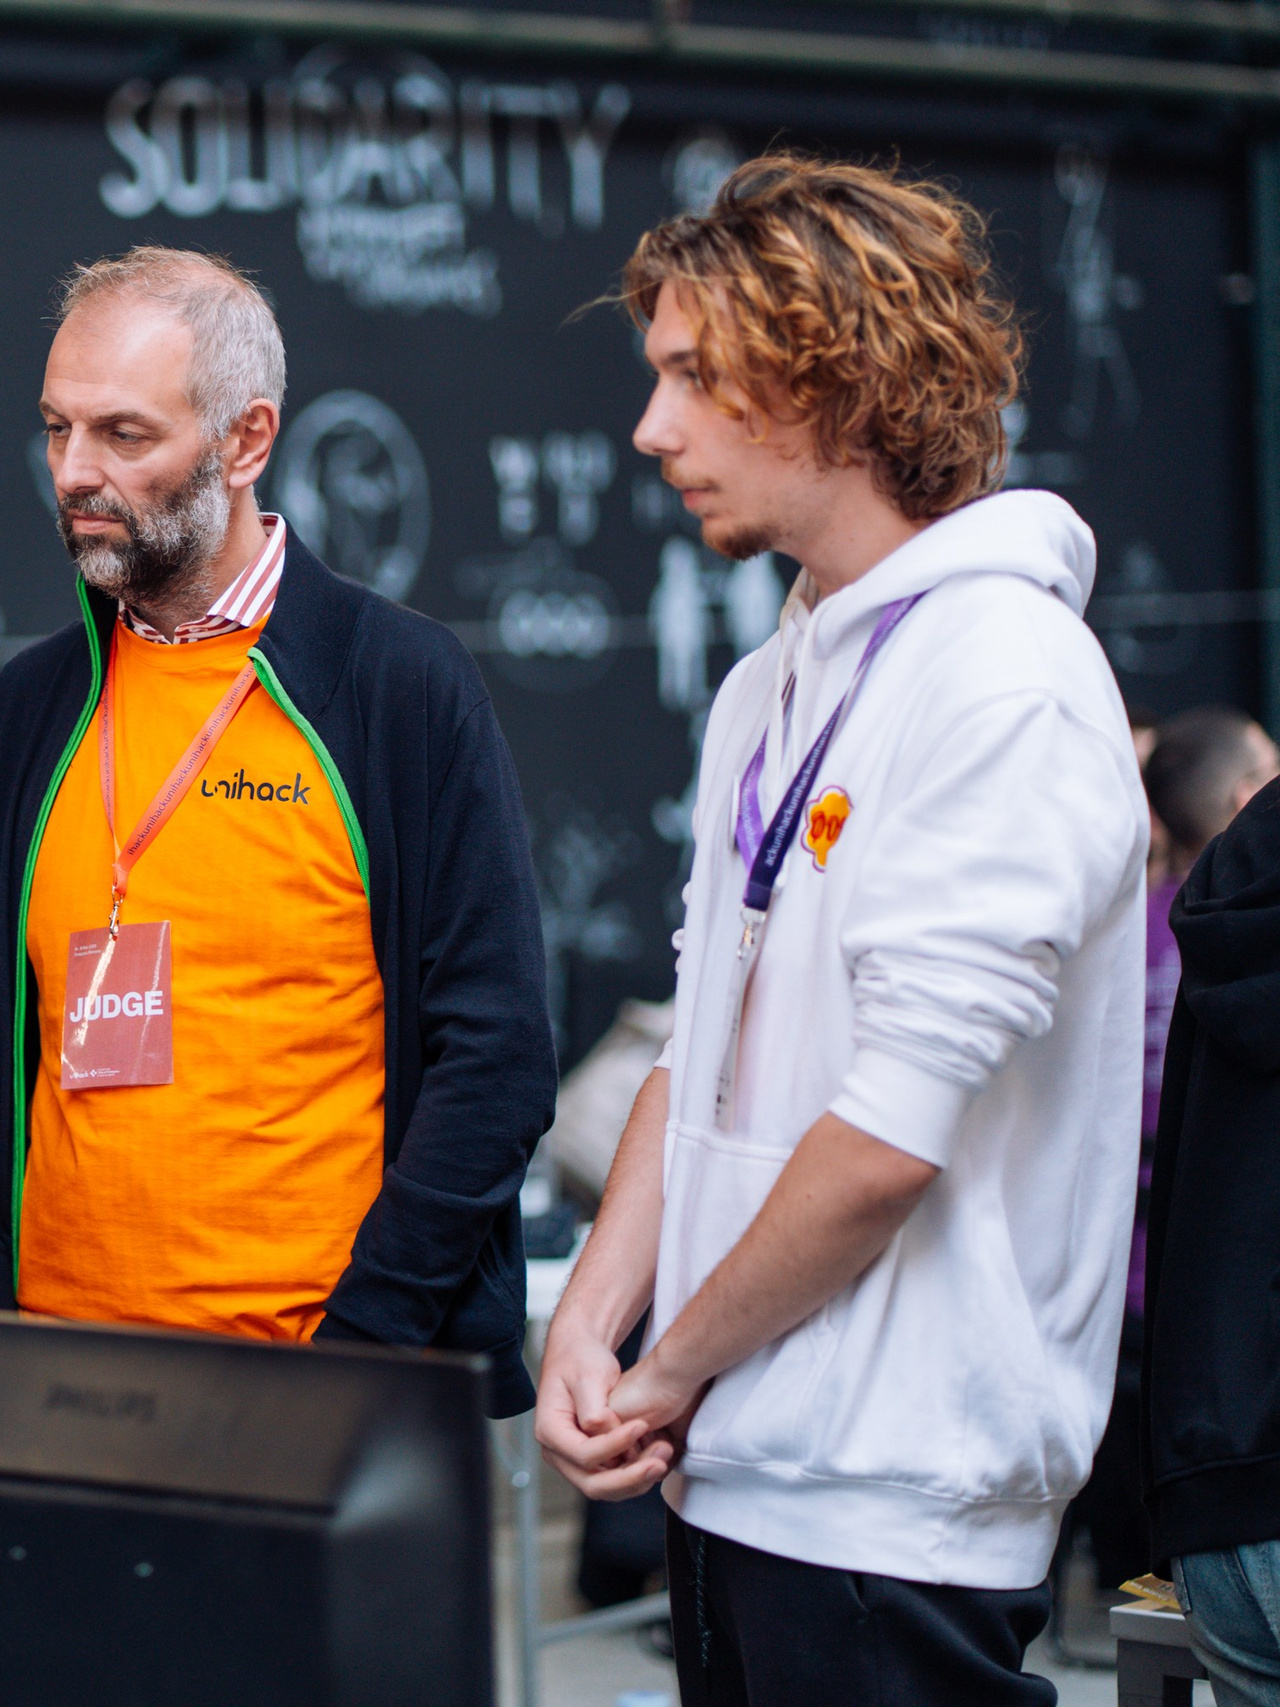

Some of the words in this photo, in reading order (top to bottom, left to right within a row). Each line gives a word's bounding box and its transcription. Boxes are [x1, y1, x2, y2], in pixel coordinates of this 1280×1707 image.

[100, 76, 631, 231] SOLIDARITY
[201, 769, 310, 805] unihack
[70, 991, 163, 1022] JUDGE
